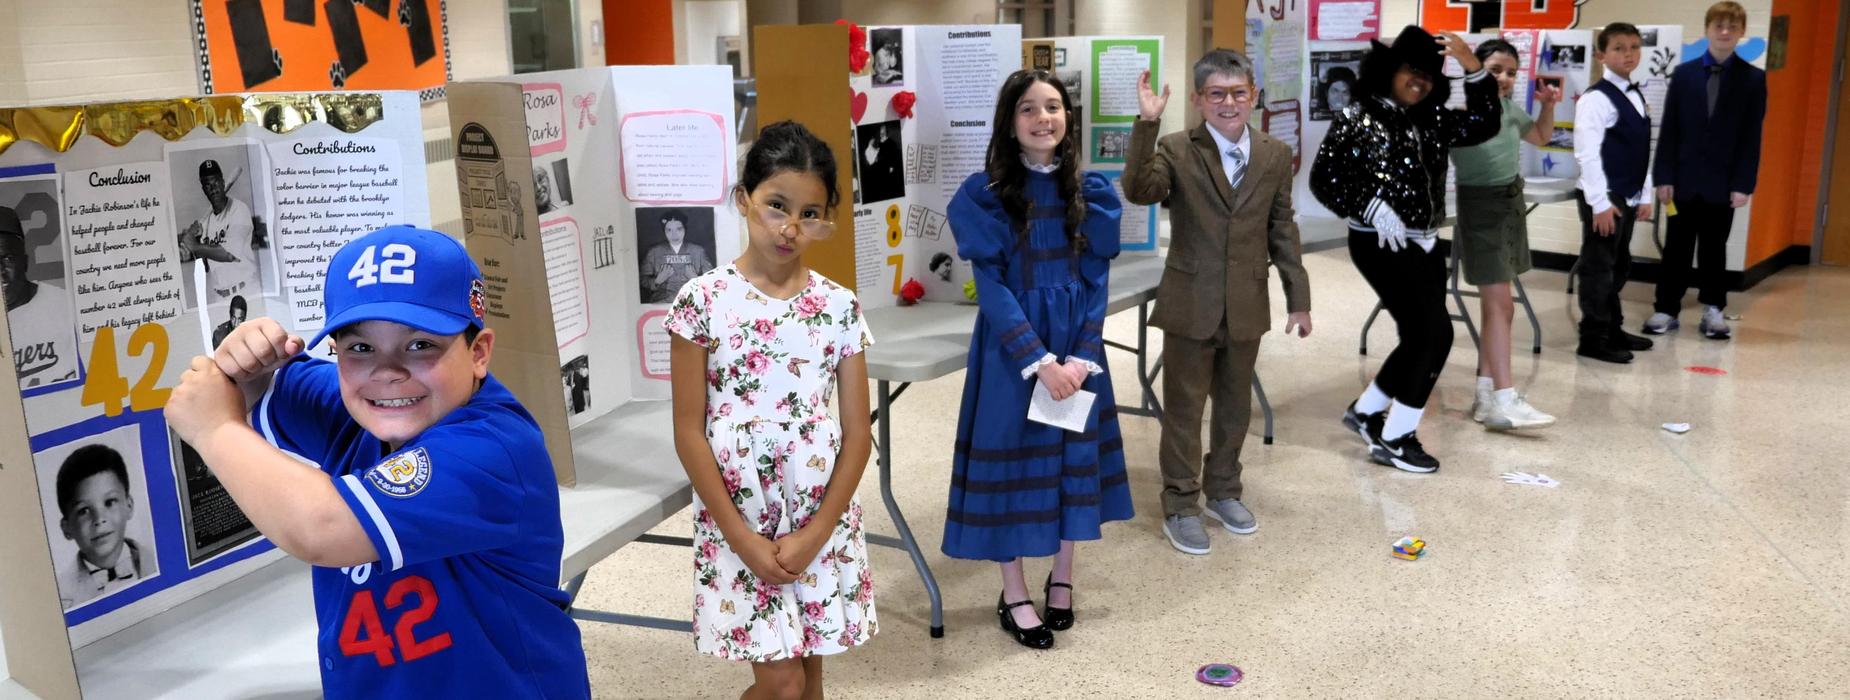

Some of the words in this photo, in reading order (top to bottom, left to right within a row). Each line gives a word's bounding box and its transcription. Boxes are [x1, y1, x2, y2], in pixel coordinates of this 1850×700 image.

[948, 31, 992, 39] Contributions
[523, 93, 558, 110] Rosa
[950, 120, 986, 128] Conclusion
[293, 140, 376, 155] Contributions
[274, 167, 297, 176] Jackie
[313, 166, 336, 176] famous
[337, 165, 348, 175] for
[349, 164, 377, 175] breaking
[378, 164, 389, 172] the
[88, 168, 151, 188] Conclusion
[276, 182, 294, 191] color
[295, 182, 320, 190] barrier
[328, 182, 348, 191] major
[350, 180, 370, 190] league
[371, 178, 398, 187] baseball
[69, 205, 77, 216] In
[79, 203, 102, 215] Jackie
[103, 199, 140, 212] Robinson's
[140, 197, 151, 210] life
[152, 197, 160, 207] he
[278, 197, 295, 206] when
[306, 196, 332, 204] debuted
[332, 195, 347, 203] with
[348, 195, 359, 203] the
[361, 193, 390, 204] brooklyn
[279, 212, 307, 223] dodgers.
[309, 211, 322, 219] His
[325, 210, 345, 218] honor
[360, 210, 385, 219] winning
[71, 223, 93, 239] helped
[93, 220, 116, 237] people
[116, 219, 129, 230] and
[129, 216, 156, 231] changed
[281, 227, 292, 235] the
[312, 225, 339, 234] valuable
[340, 225, 363, 236] player.
[364, 223, 374, 231] To
[74, 242, 101, 255] baseball
[102, 241, 129, 254] forever.
[130, 238, 143, 249] For
[144, 238, 156, 246] our
[296, 242, 321, 251] country
[322, 240, 342, 248] better
[76, 263, 101, 276] country
[113, 258, 128, 269] need
[146, 253, 167, 269] people
[284, 256, 315, 267] improved
[316, 255, 327, 263] the
[347, 243, 416, 288] 42
[77, 284, 91, 294] like
[92, 282, 107, 292] him.
[108, 280, 133, 292] Anyone
[134, 275, 147, 285] who
[162, 271, 173, 281] the
[286, 271, 315, 280] breaking
[294, 284, 323, 294] baseball.
[80, 302, 105, 314] number
[106, 302, 116, 310] 42
[118, 296, 131, 308] will
[132, 295, 155, 307] always
[155, 290, 172, 301] think
[173, 288, 180, 301] of
[296, 300, 319, 308] MLB
[82, 323, 95, 334] him
[110, 318, 120, 328] his
[121, 316, 141, 329] legacy
[142, 311, 154, 323] left
[155, 307, 177, 320] behind.
[299, 313, 323, 322] number
[81, 322, 174, 417] 42
[338, 575, 453, 668] 42
